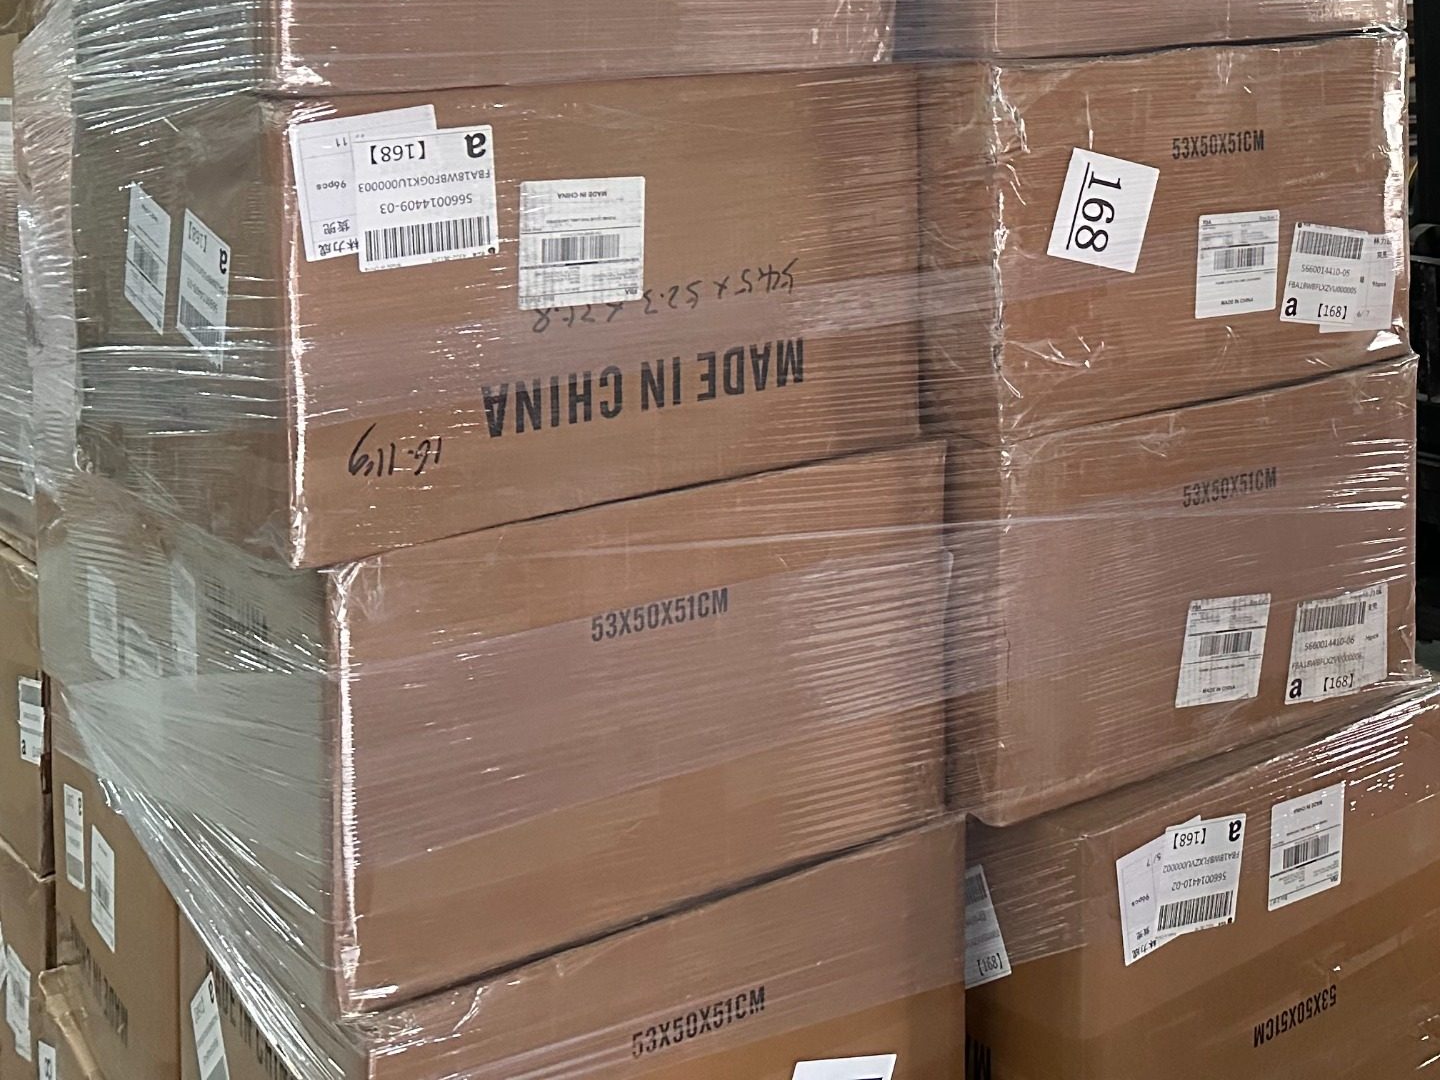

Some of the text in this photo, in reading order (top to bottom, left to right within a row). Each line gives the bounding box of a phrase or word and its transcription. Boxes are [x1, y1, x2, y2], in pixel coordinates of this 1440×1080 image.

[370, 140, 426, 165] 【168】
[464, 133, 487, 158] a
[1172, 129, 1265, 161] 53X50X51CM
[380, 192, 473, 214] 5660014409-03
[1074, 170, 1123, 254] 168
[1284, 297, 1348, 320] a 【168】
[481, 338, 805, 438] MADE IN CHINA
[1183, 466, 1278, 508] 53X50X51CM
[592, 587, 729, 642] 53X50X51CM
[1289, 673, 1354, 699] a 【168】
[1174, 820, 1242, 849] 【168】 a
[632, 986, 766, 1059] 53X50X51CM
[1253, 984, 1338, 1048] 53X50X51CM
